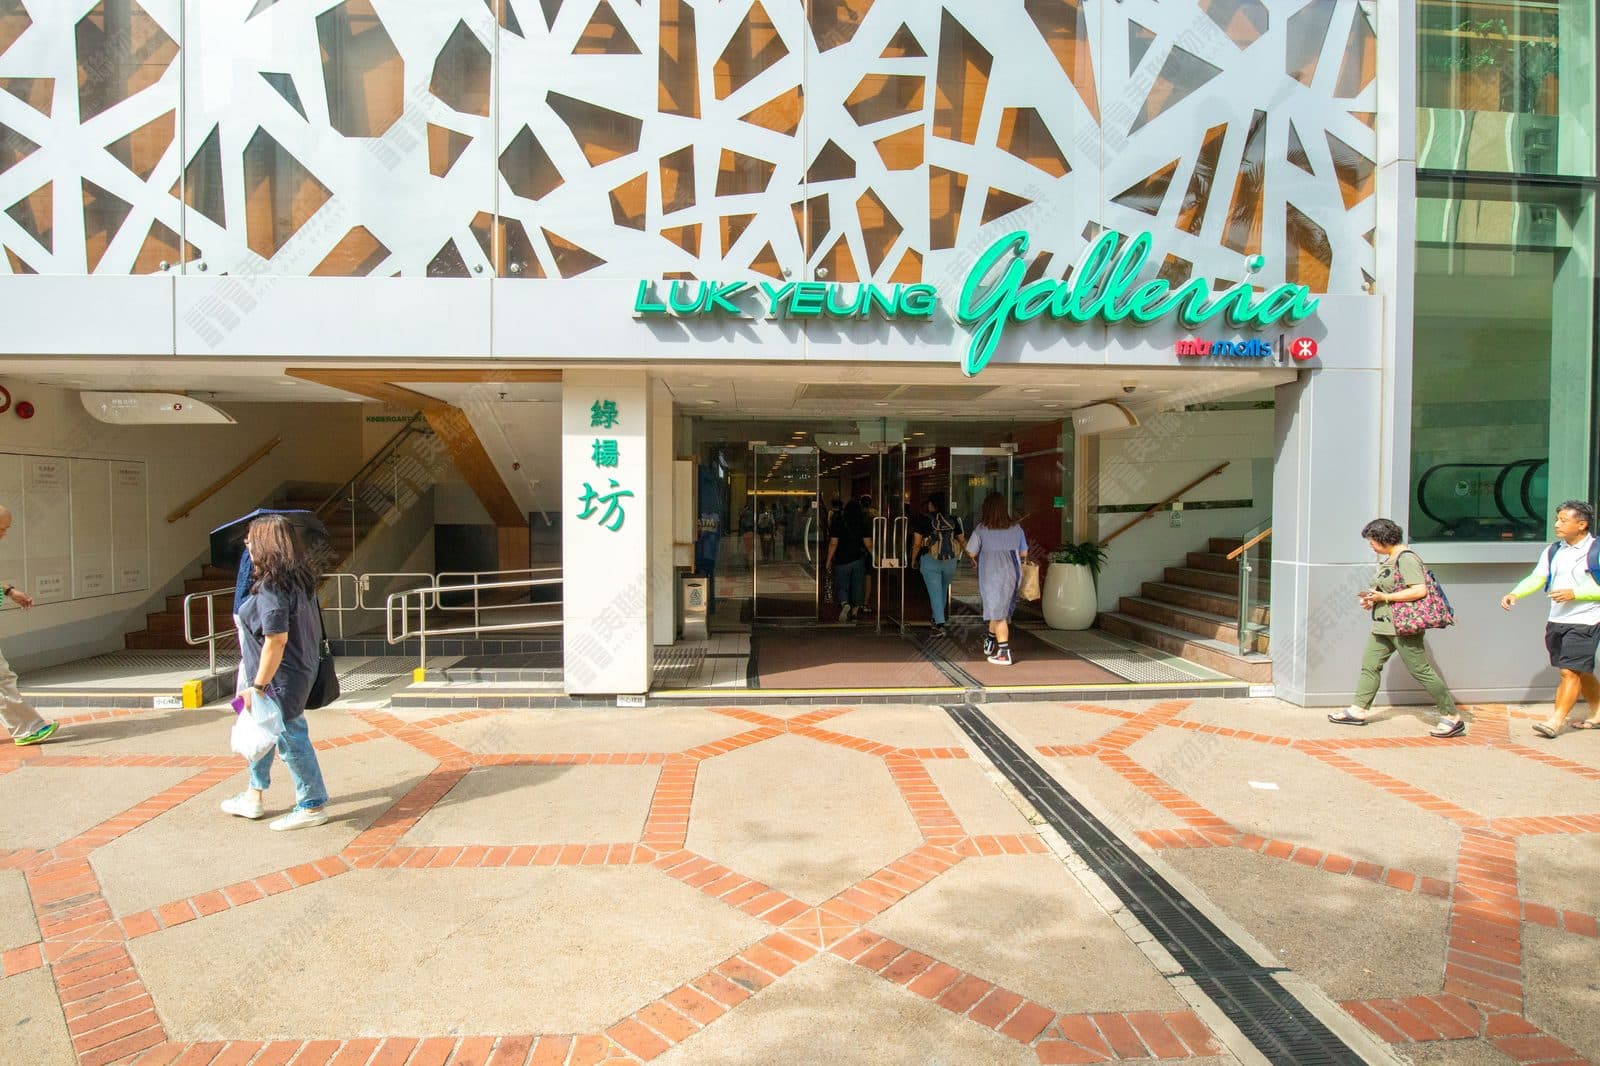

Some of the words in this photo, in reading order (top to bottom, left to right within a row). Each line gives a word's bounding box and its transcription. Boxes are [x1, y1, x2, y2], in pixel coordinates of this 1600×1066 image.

[635, 279, 747, 317] LUK
[760, 281, 937, 318] YEUNG
[956, 230, 1320, 377] Galleria
